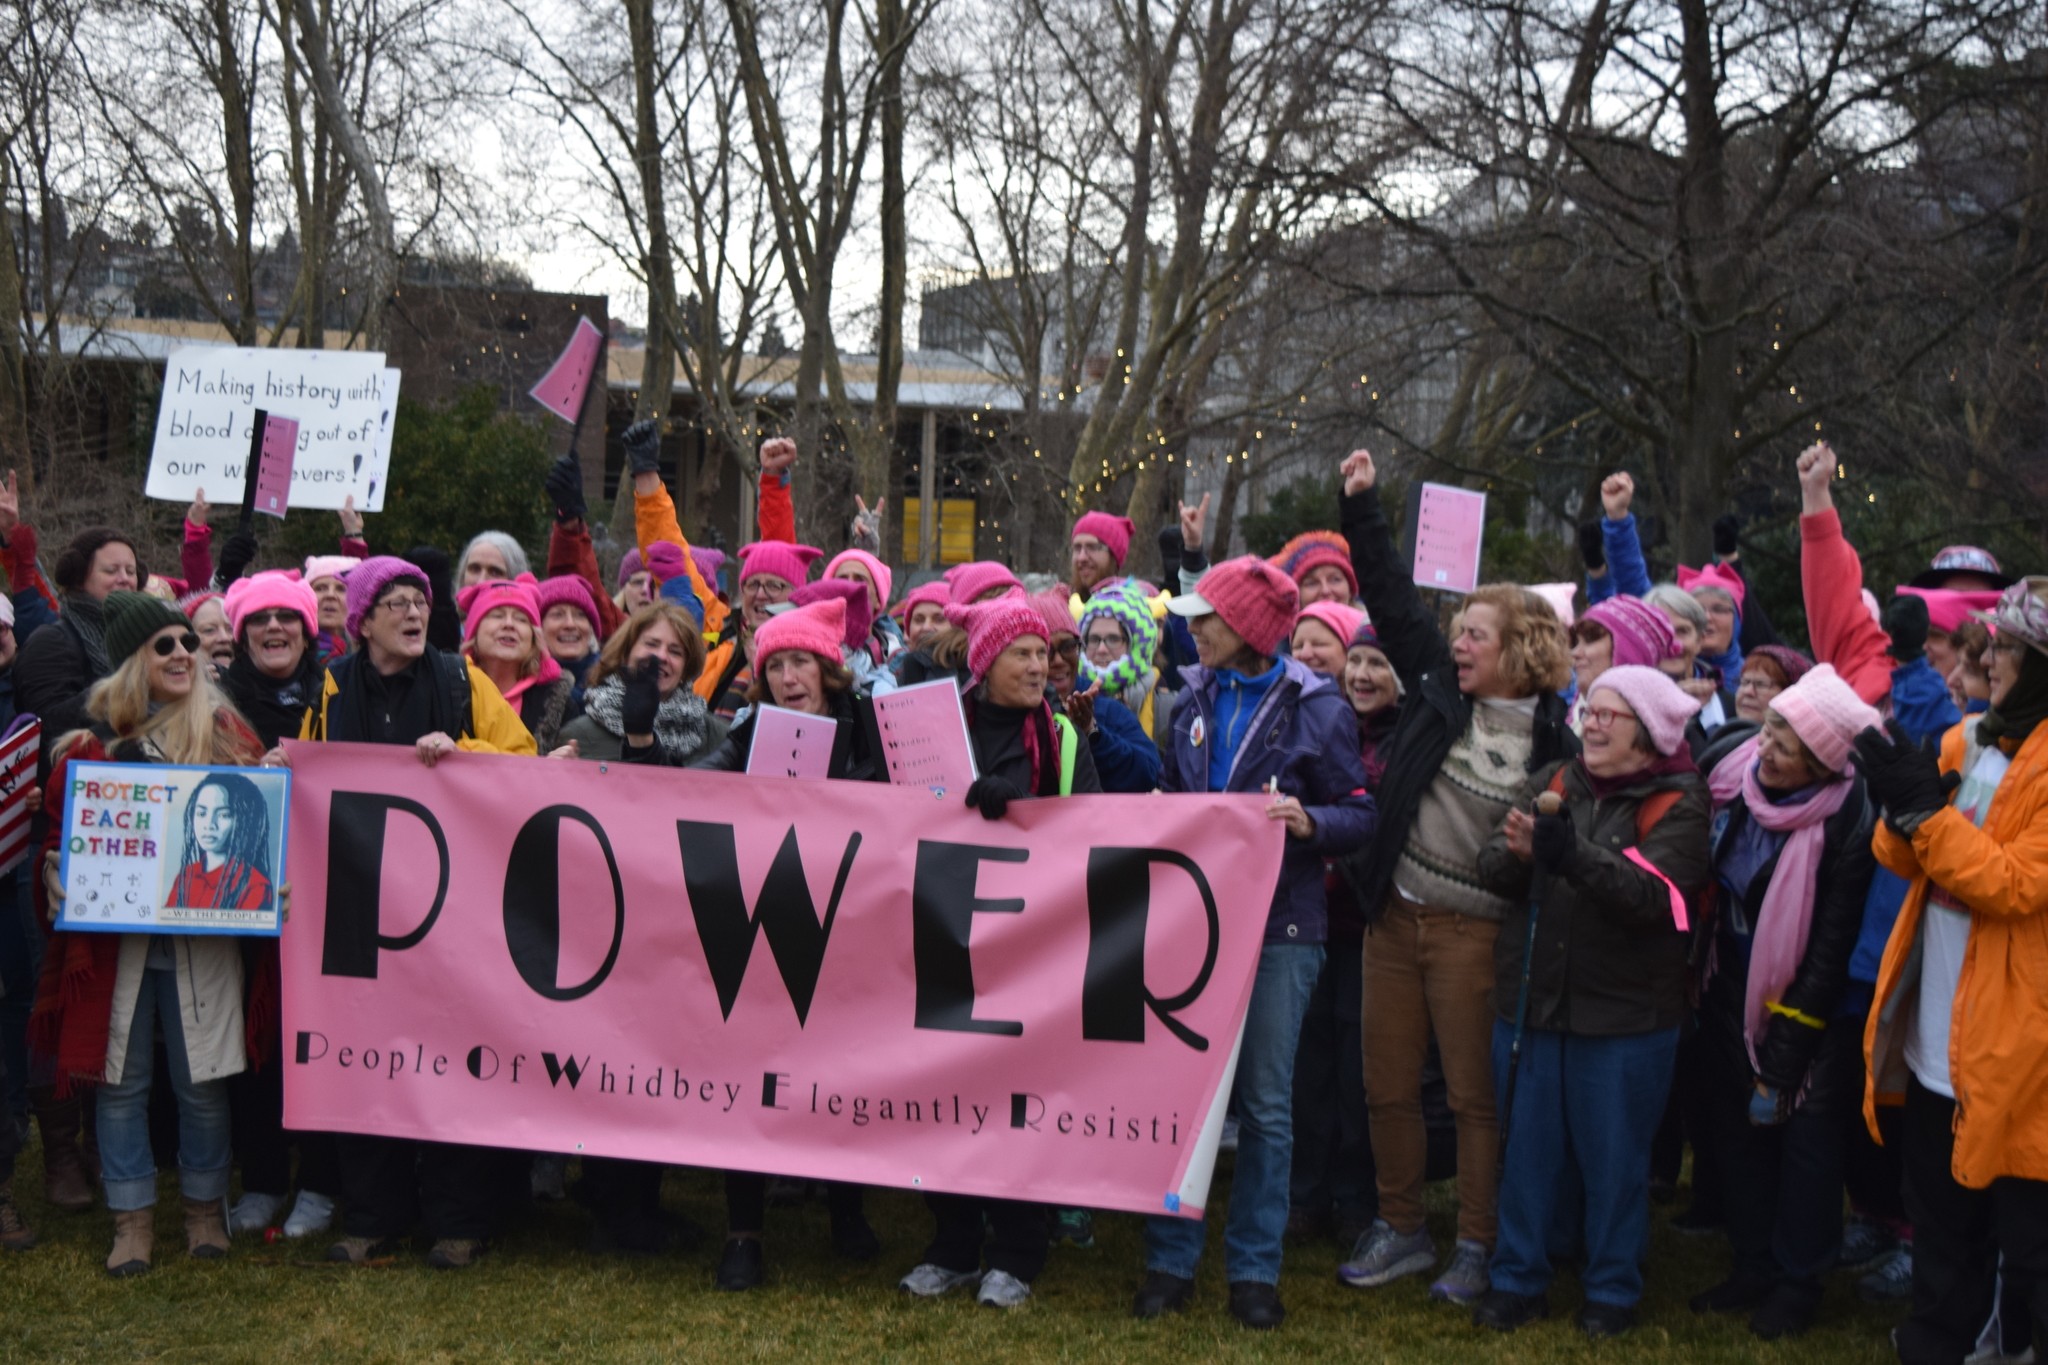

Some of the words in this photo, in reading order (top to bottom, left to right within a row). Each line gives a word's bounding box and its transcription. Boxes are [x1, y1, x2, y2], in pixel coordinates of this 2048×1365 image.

[177, 367, 255, 405] Making
[266, 369, 342, 410] history
[348, 372, 382, 401] with
[169, 408, 234, 439] blood
[316, 424, 342, 441] out
[347, 418, 374, 441] of
[166, 460, 206, 476] our
[72, 780, 178, 803] PROTECT
[80, 808, 151, 830] EACH
[68, 836, 157, 858] OTHER
[173, 909, 192, 919] WE
[196, 910, 217, 919] THE
[220, 910, 262, 920] PEOPLE
[321, 789, 1220, 1052] POWER
[295, 1030, 448, 1079] People
[466, 1044, 526, 1084] Of
[541, 1050, 741, 1112] Whidbey
[761, 1071, 990, 1136] Elegantly
[1010, 1092, 1178, 1146] Resisti
